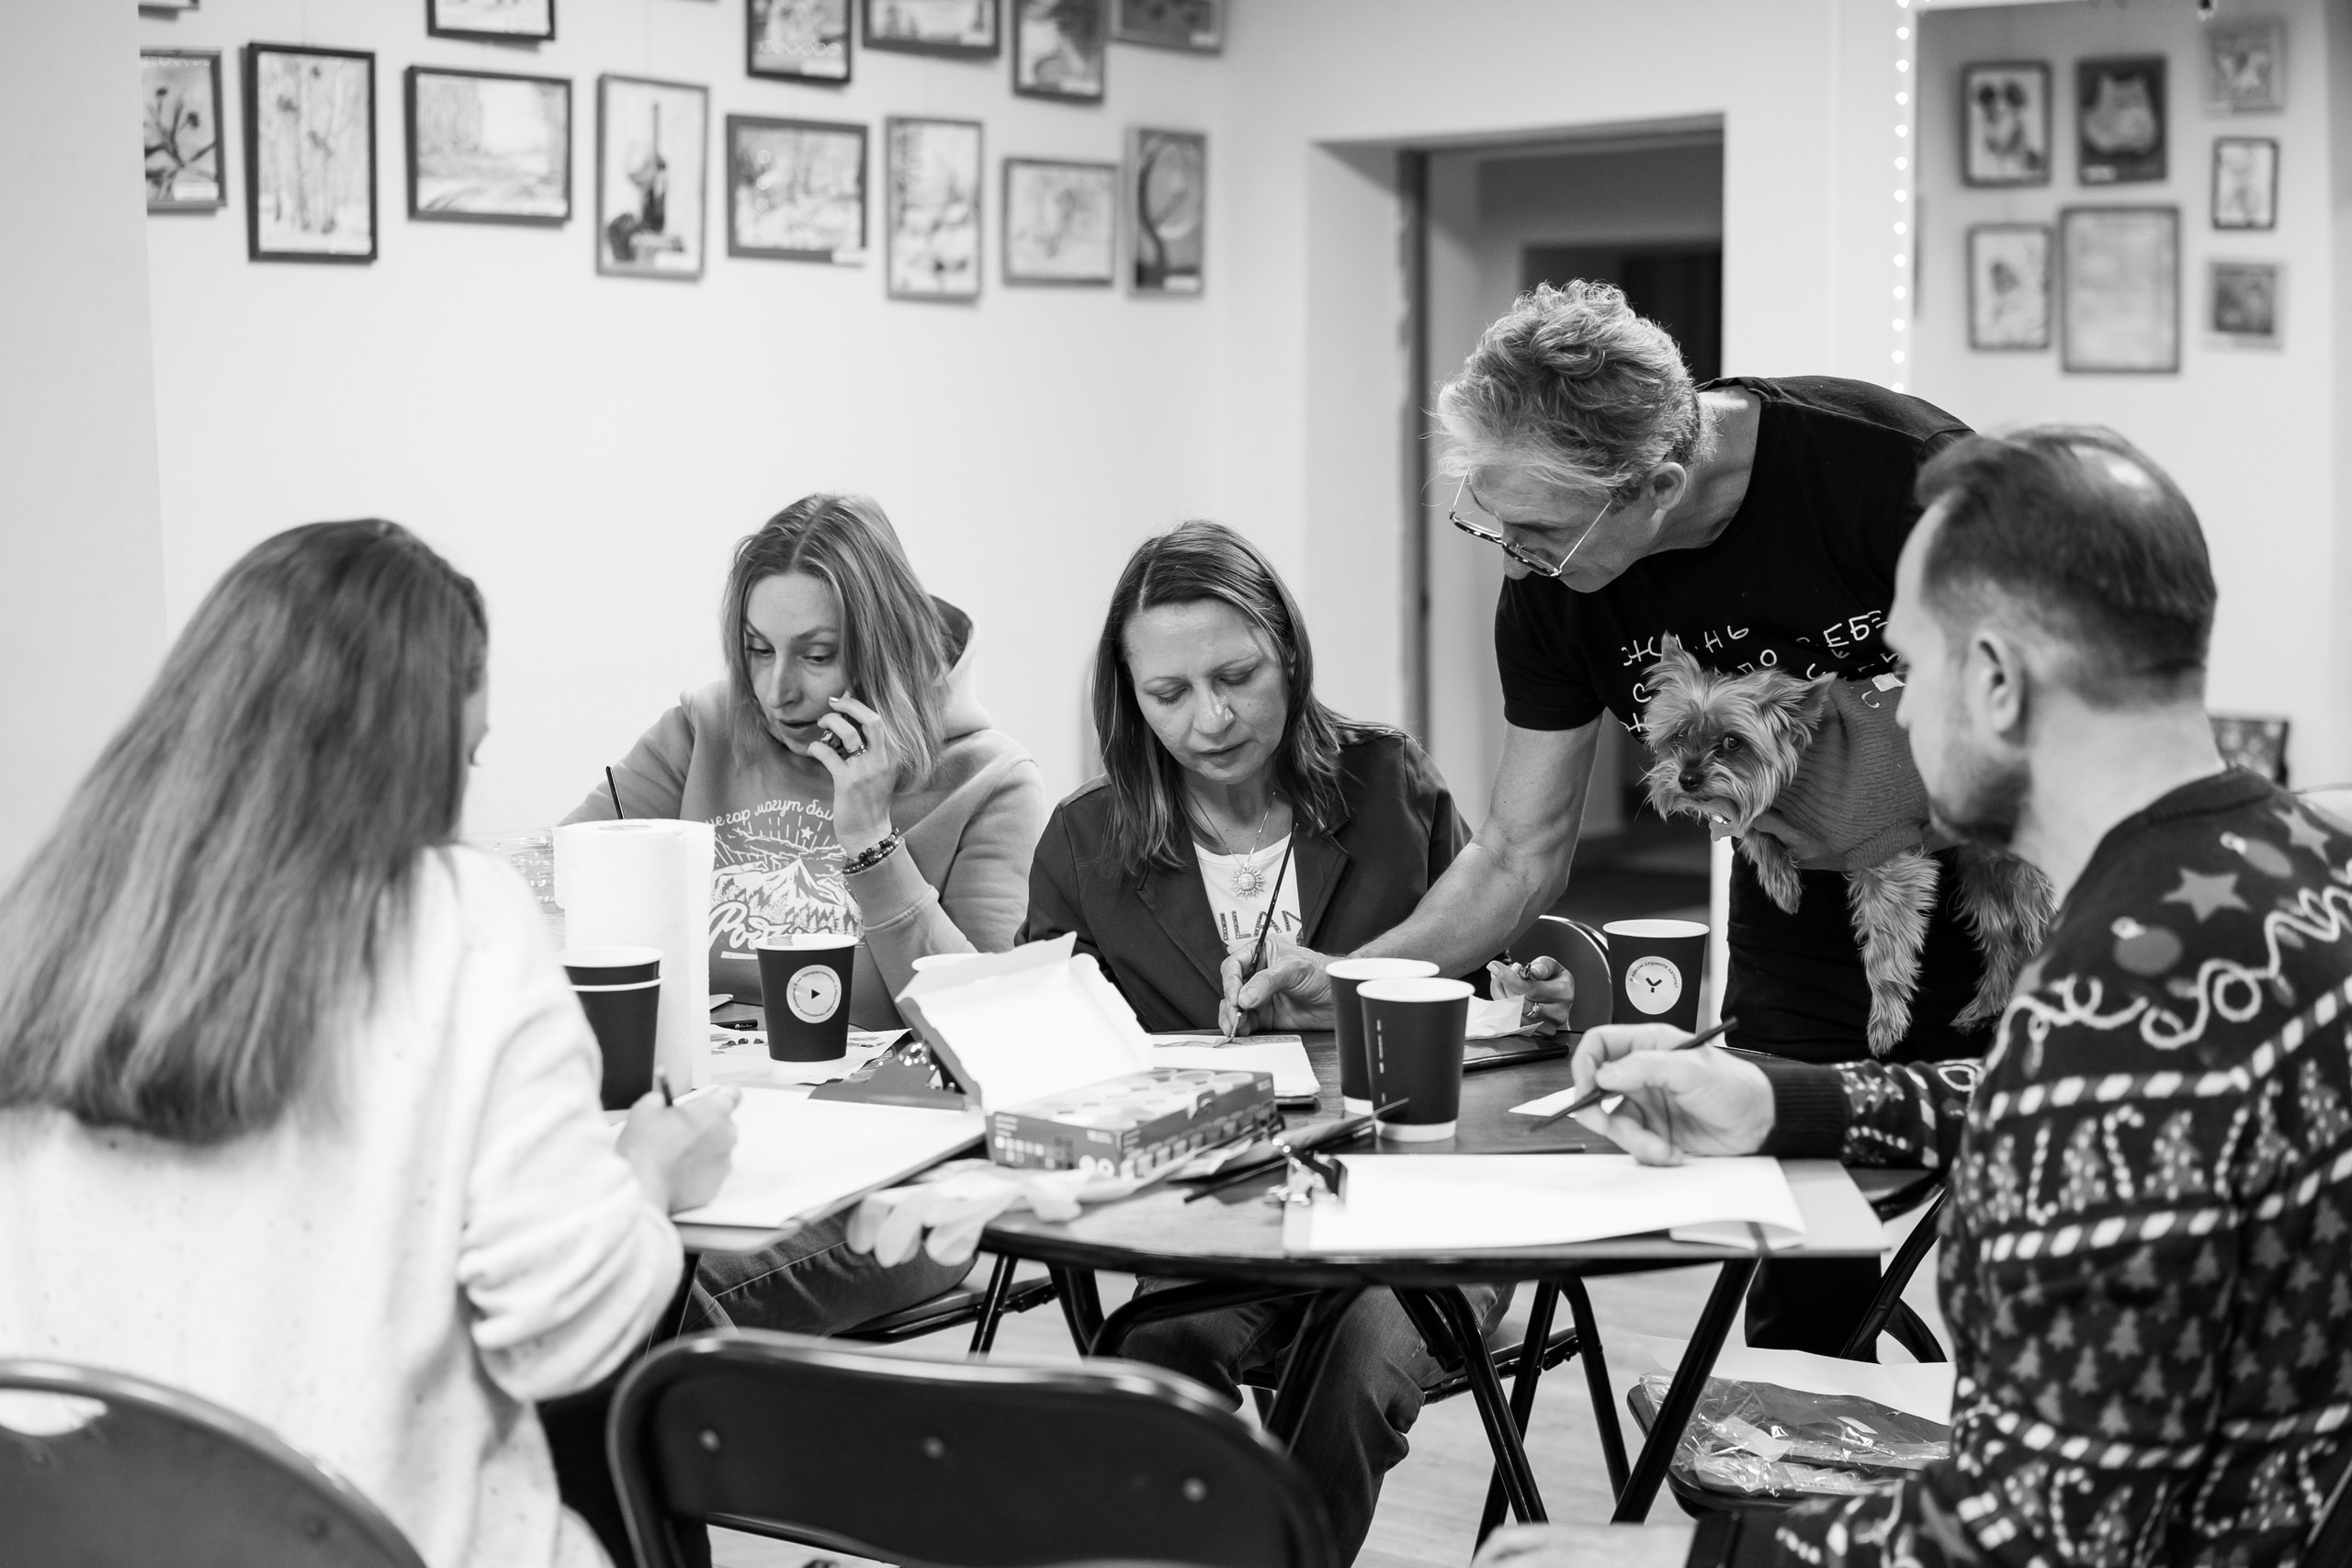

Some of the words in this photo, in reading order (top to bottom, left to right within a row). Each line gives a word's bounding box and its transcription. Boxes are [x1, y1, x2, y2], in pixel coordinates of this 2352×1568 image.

[1621, 626, 1749, 667] ЖНЬ
[754, 799, 804, 818] могут
[806, 799, 833, 822] бы
[1645, 961, 1668, 969] спринте
